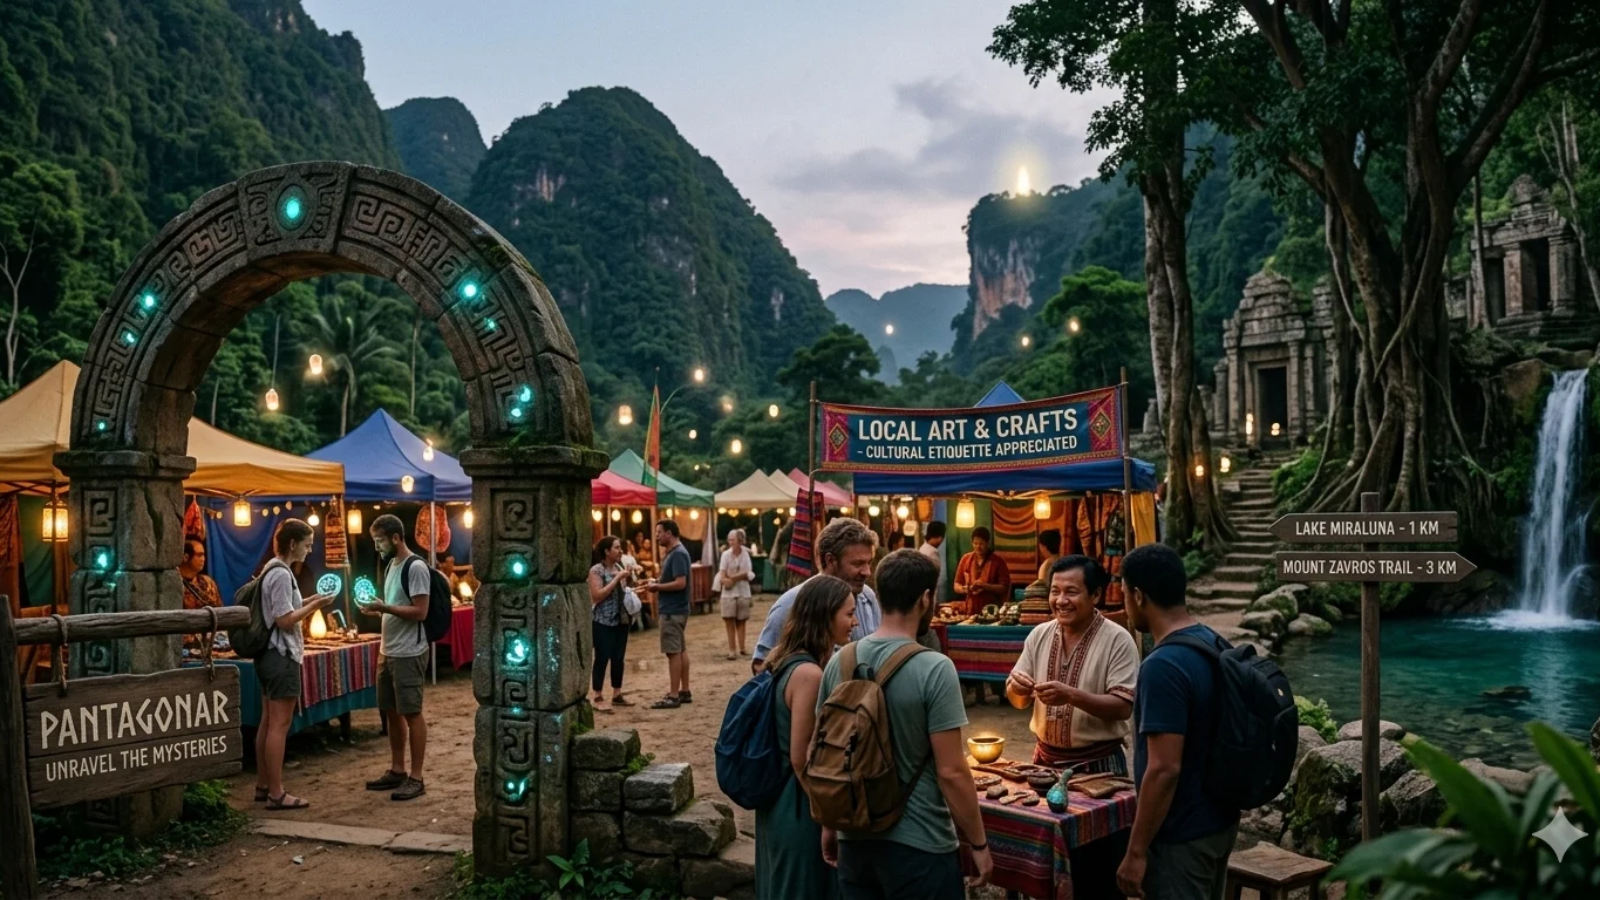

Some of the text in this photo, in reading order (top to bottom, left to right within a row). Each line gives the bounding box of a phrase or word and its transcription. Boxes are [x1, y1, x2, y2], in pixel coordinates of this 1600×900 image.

[859, 408, 1078, 441] LOCAL ART & CRAFTS
[866, 444, 926, 460] CULTURAL
[928, 443, 993, 460] ETIQUETTE
[995, 435, 1078, 457] APPRECIATED
[1296, 520, 1327, 536] LAKE
[1330, 520, 1395, 536] MIRALUNA
[1409, 521, 1416, 536] 1
[1420, 520, 1439, 536] KM
[1283, 560, 1326, 575] MOUNT
[1329, 560, 1376, 575] ZAVROS
[1378, 560, 1413, 575] TRAIL
[1426, 560, 1434, 575] 3
[1438, 560, 1457, 575] KM
[41, 690, 230, 749] PANTAGONAR
[46, 735, 228, 782] UNRAVEL THE MYSTERIES
